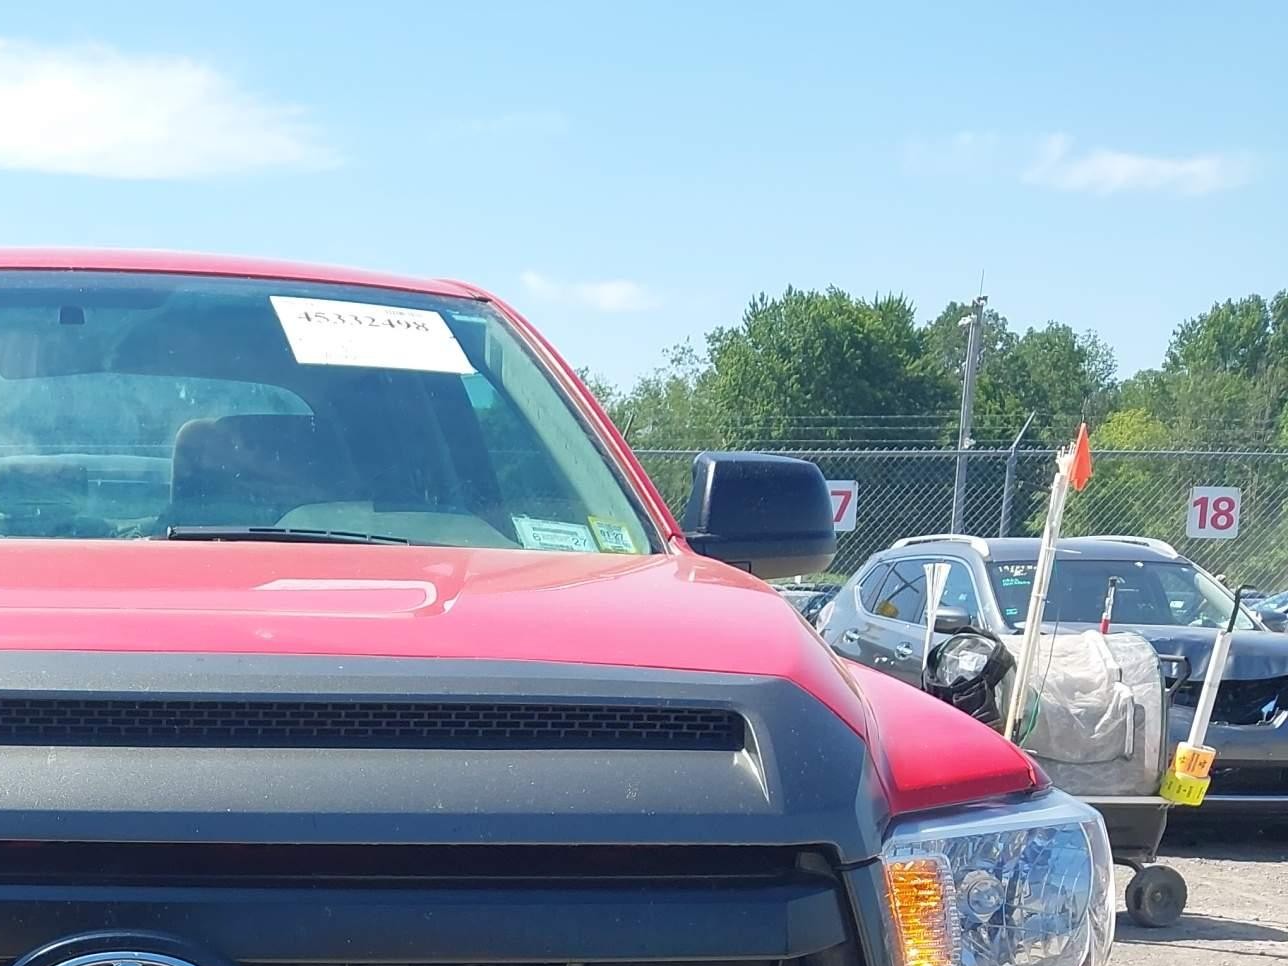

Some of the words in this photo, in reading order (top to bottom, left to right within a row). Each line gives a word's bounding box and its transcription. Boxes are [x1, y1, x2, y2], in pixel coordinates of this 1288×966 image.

[297, 311, 430, 332] 45332498
[830, 490, 852, 522] 7
[1192, 496, 1236, 530] 18
